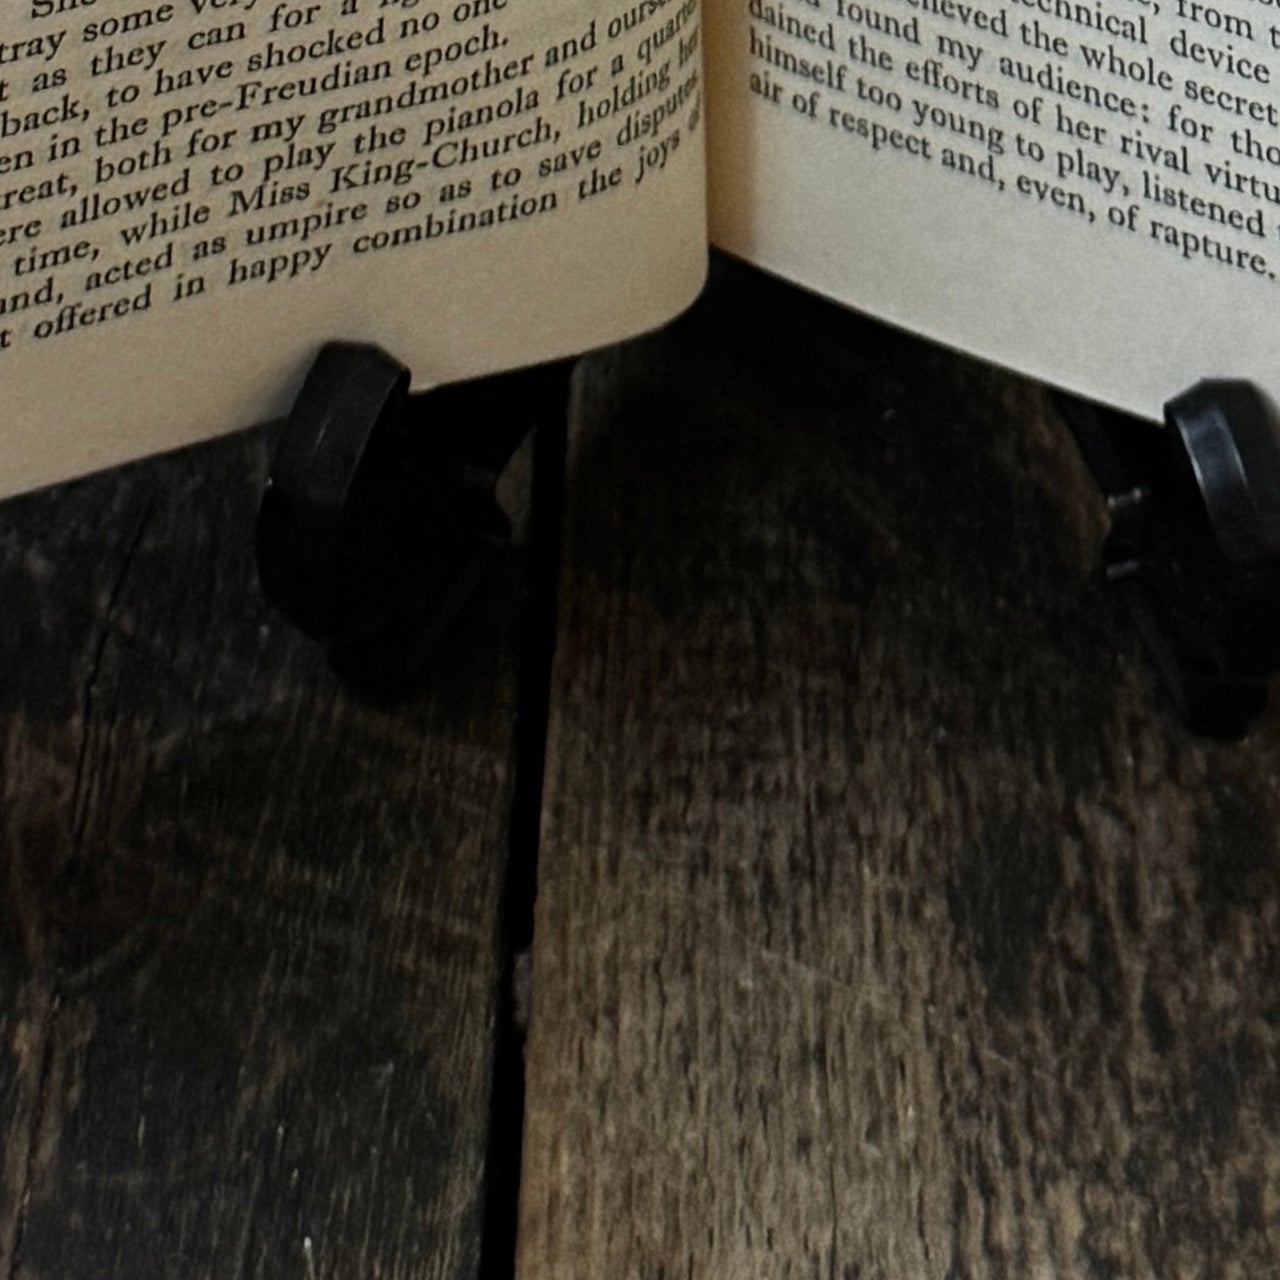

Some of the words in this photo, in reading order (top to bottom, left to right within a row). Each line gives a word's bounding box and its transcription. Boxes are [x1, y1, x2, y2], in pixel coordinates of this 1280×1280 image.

[47, 133, 82, 164] in
[94, 115, 149, 148] the
[160, 59, 394, 138] pre-Freudian
[404, 23, 509, 79] epoch.
[848, 34, 894, 73] the
[905, 58, 1000, 110] efforts
[1012, 96, 1044, 126] of
[1055, 103, 1107, 146] her
[1120, 129, 1192, 176] rival
